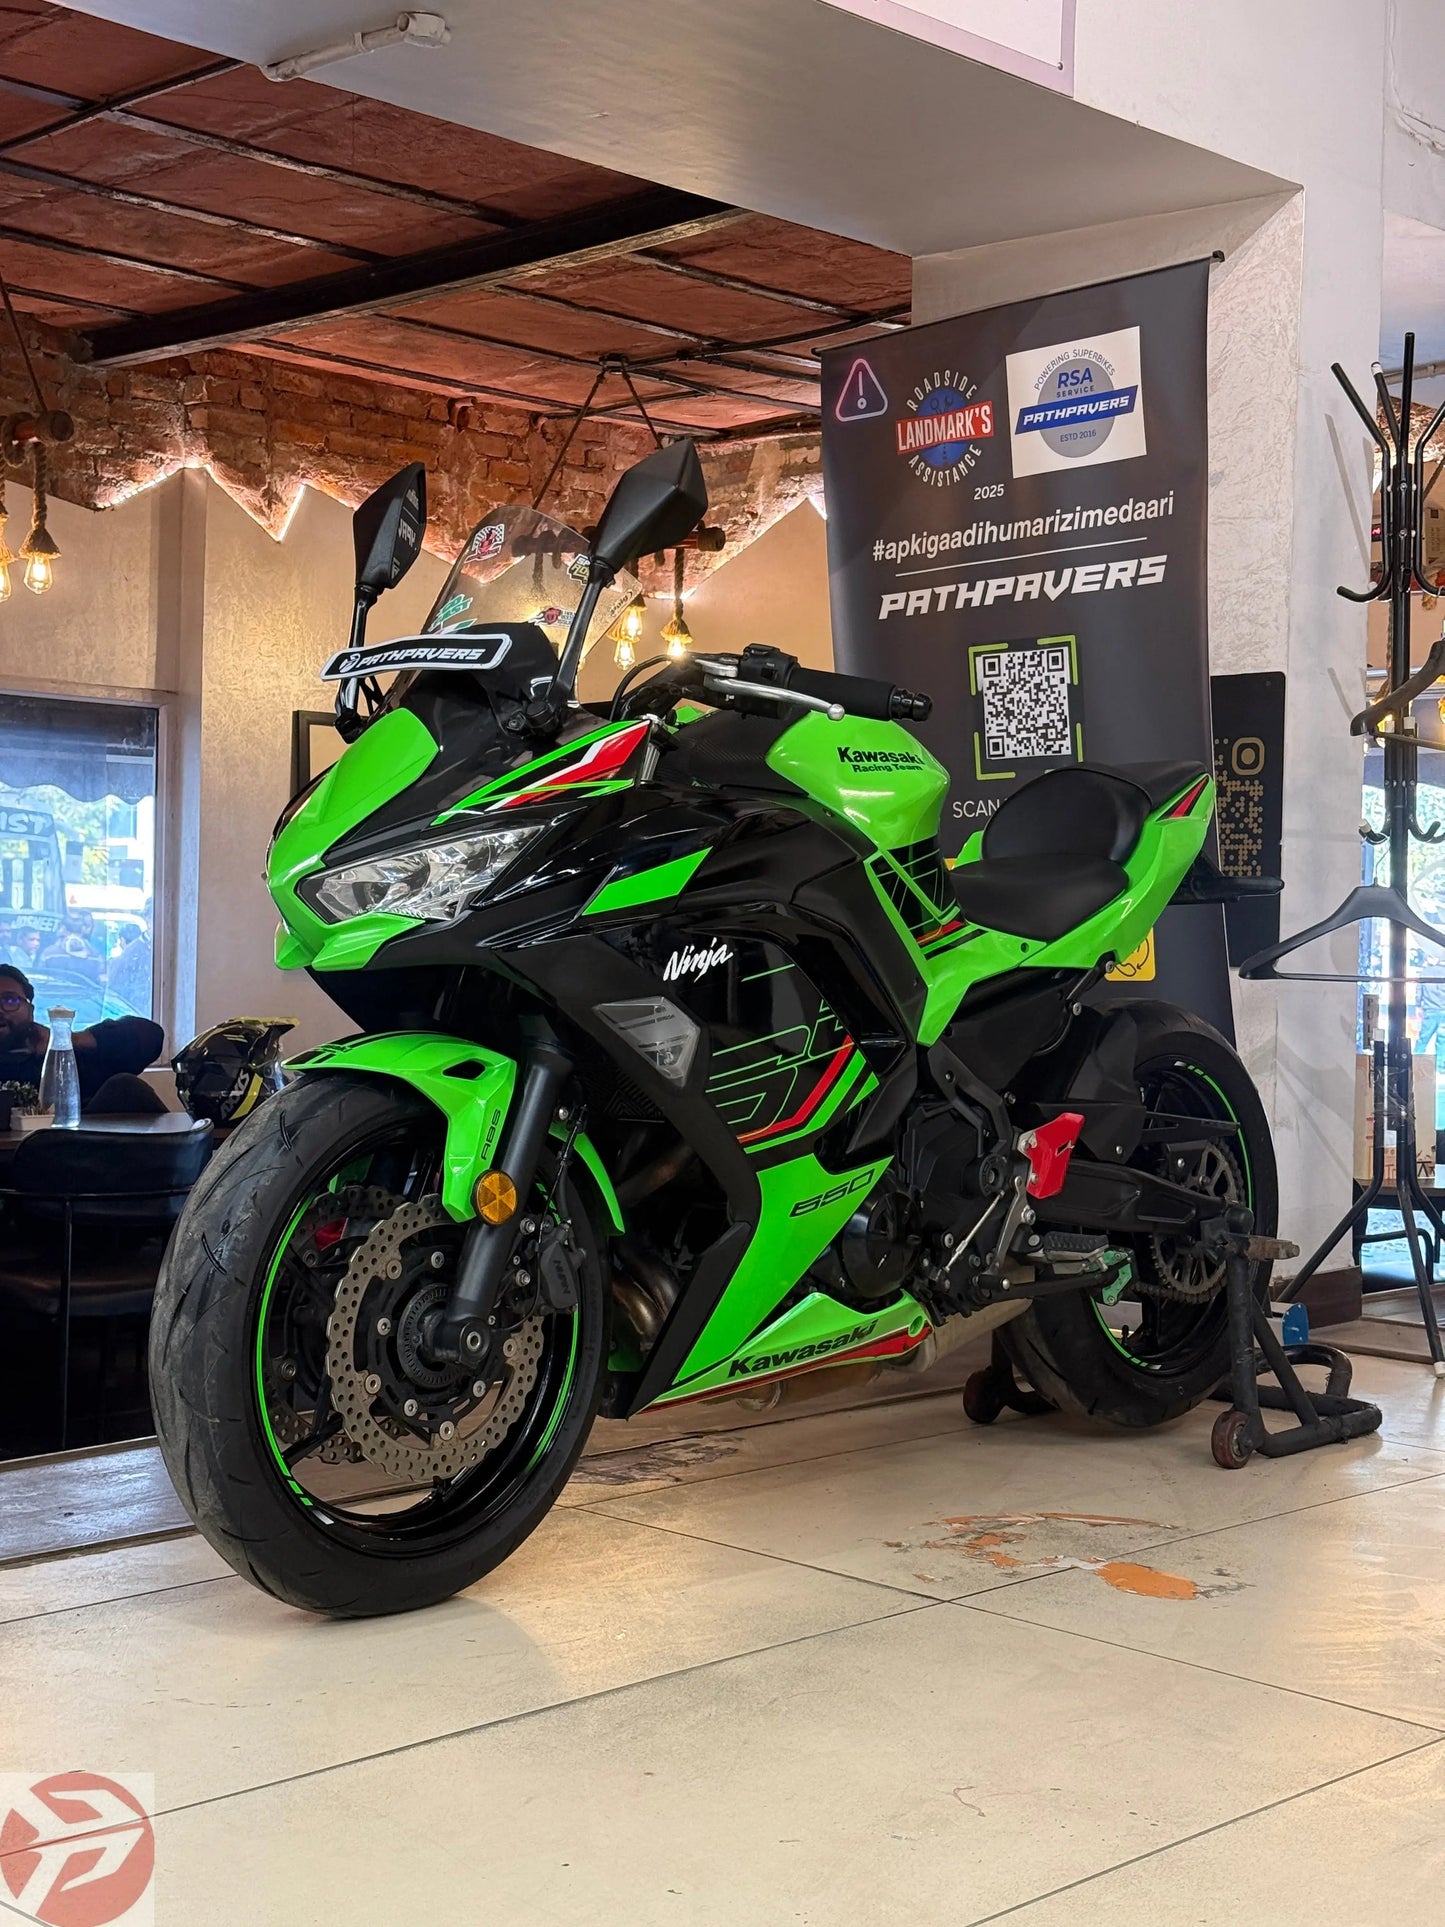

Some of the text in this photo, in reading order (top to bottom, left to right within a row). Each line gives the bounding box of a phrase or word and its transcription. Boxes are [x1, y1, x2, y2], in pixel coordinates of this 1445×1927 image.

[1034, 348, 1116, 391] POWERING SUPERBIKES
[1057, 367, 1093, 389] RSA
[906, 370, 978, 412] ROADSIDE
[1023, 395, 1130, 426] PATHPAVERS
[1056, 385, 1095, 398] SERVICE
[897, 405, 992, 451] LANDMARK'S
[1060, 429, 1097, 443] ESTD 2016
[908, 444, 982, 487] ASSISTANCE
[974, 484, 1005, 500] 2025
[872, 490, 1174, 564] #apkigaadihumarizimedaari
[878, 554, 1168, 621] PATHPAVERS
[356, 647, 487, 669] PATHPAVERS
[837, 746, 926, 765] Kawasaki
[852, 763, 924, 773] Racing Team
[952, 799, 1000, 819] SCAN
[663, 937, 734, 983] Ninja
[480, 1108, 502, 1162] ABS
[788, 1168, 876, 1218] 650
[727, 1318, 879, 1378] Kawasaki
